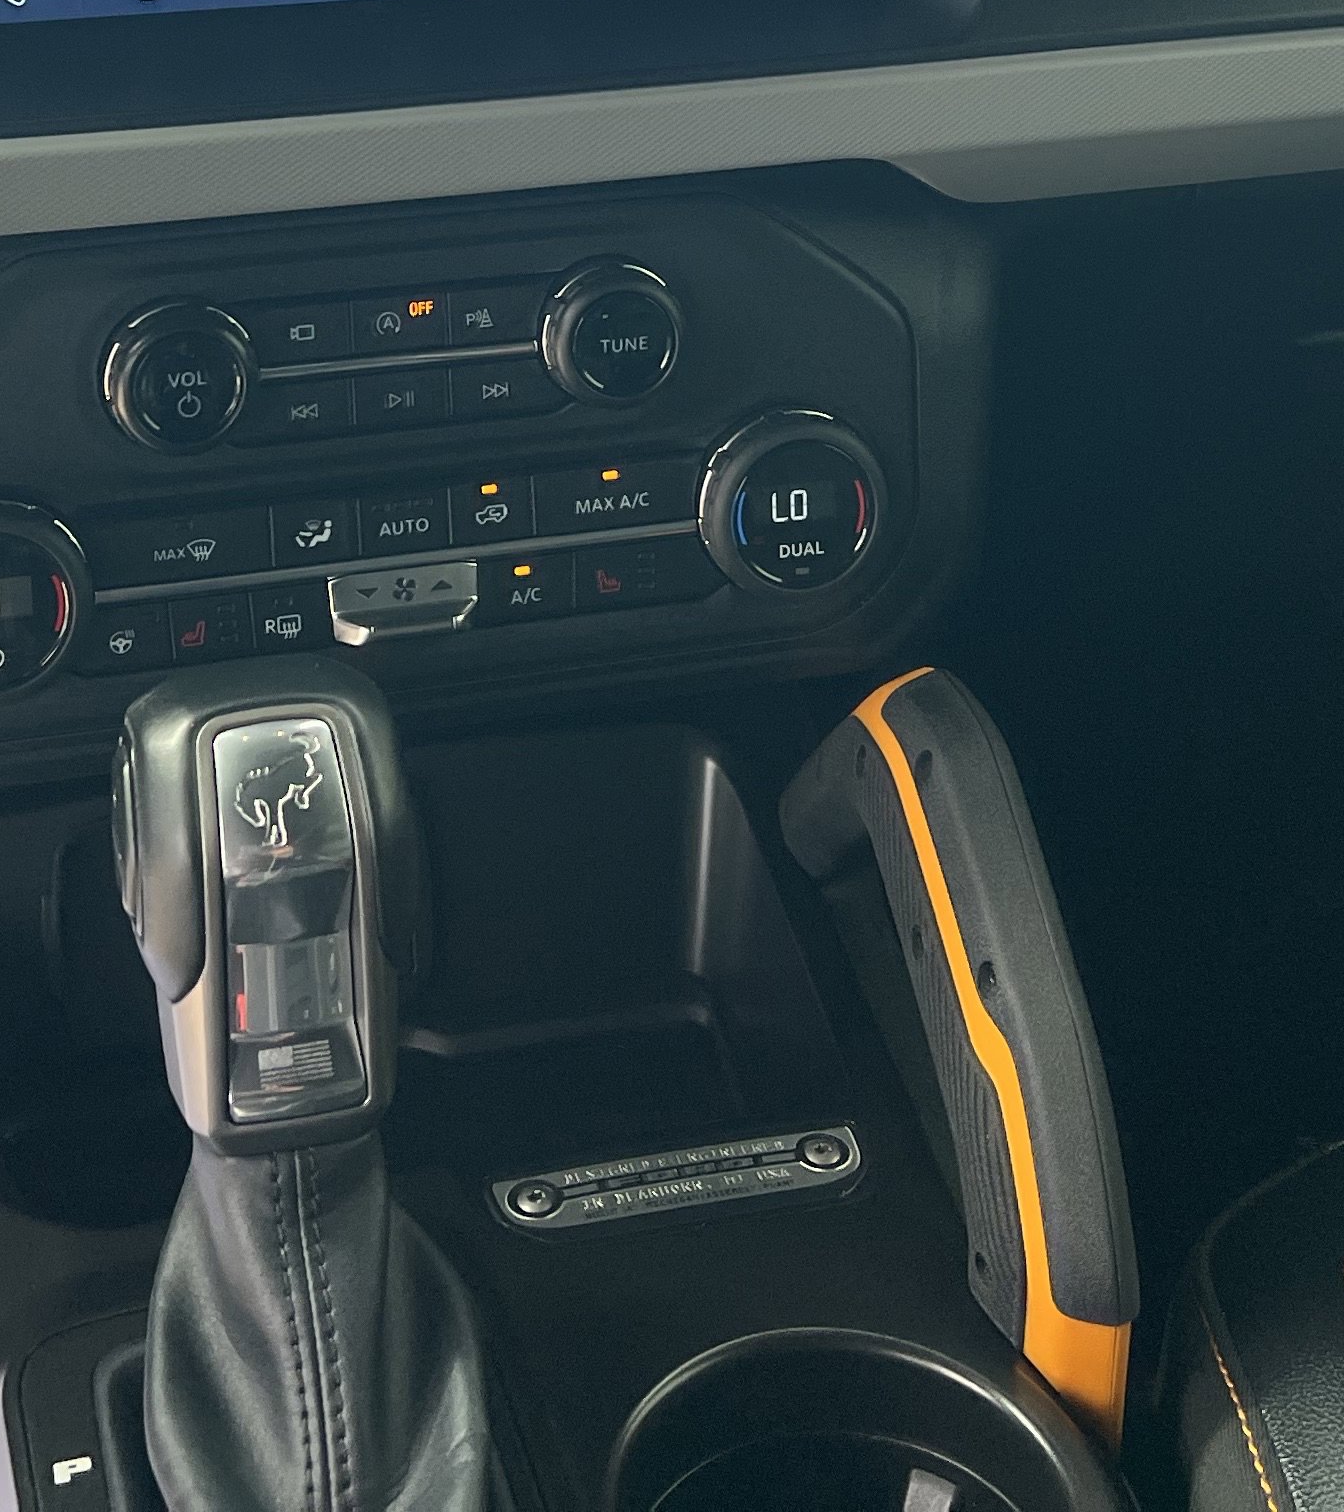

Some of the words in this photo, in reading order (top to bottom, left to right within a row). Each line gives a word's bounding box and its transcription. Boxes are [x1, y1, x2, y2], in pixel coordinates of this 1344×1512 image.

[408, 300, 434, 317] OFF
[600, 335, 649, 355] TUNE
[168, 372, 207, 389] VOL
[575, 497, 615, 515] MAX
[619, 491, 651, 511] A/C
[770, 489, 808, 523] LO
[379, 518, 430, 537] AUTO
[154, 547, 186, 562] MAX
[779, 540, 824, 559] DUAL
[511, 587, 543, 605] A/C
[53, 1456, 92, 1485] P
